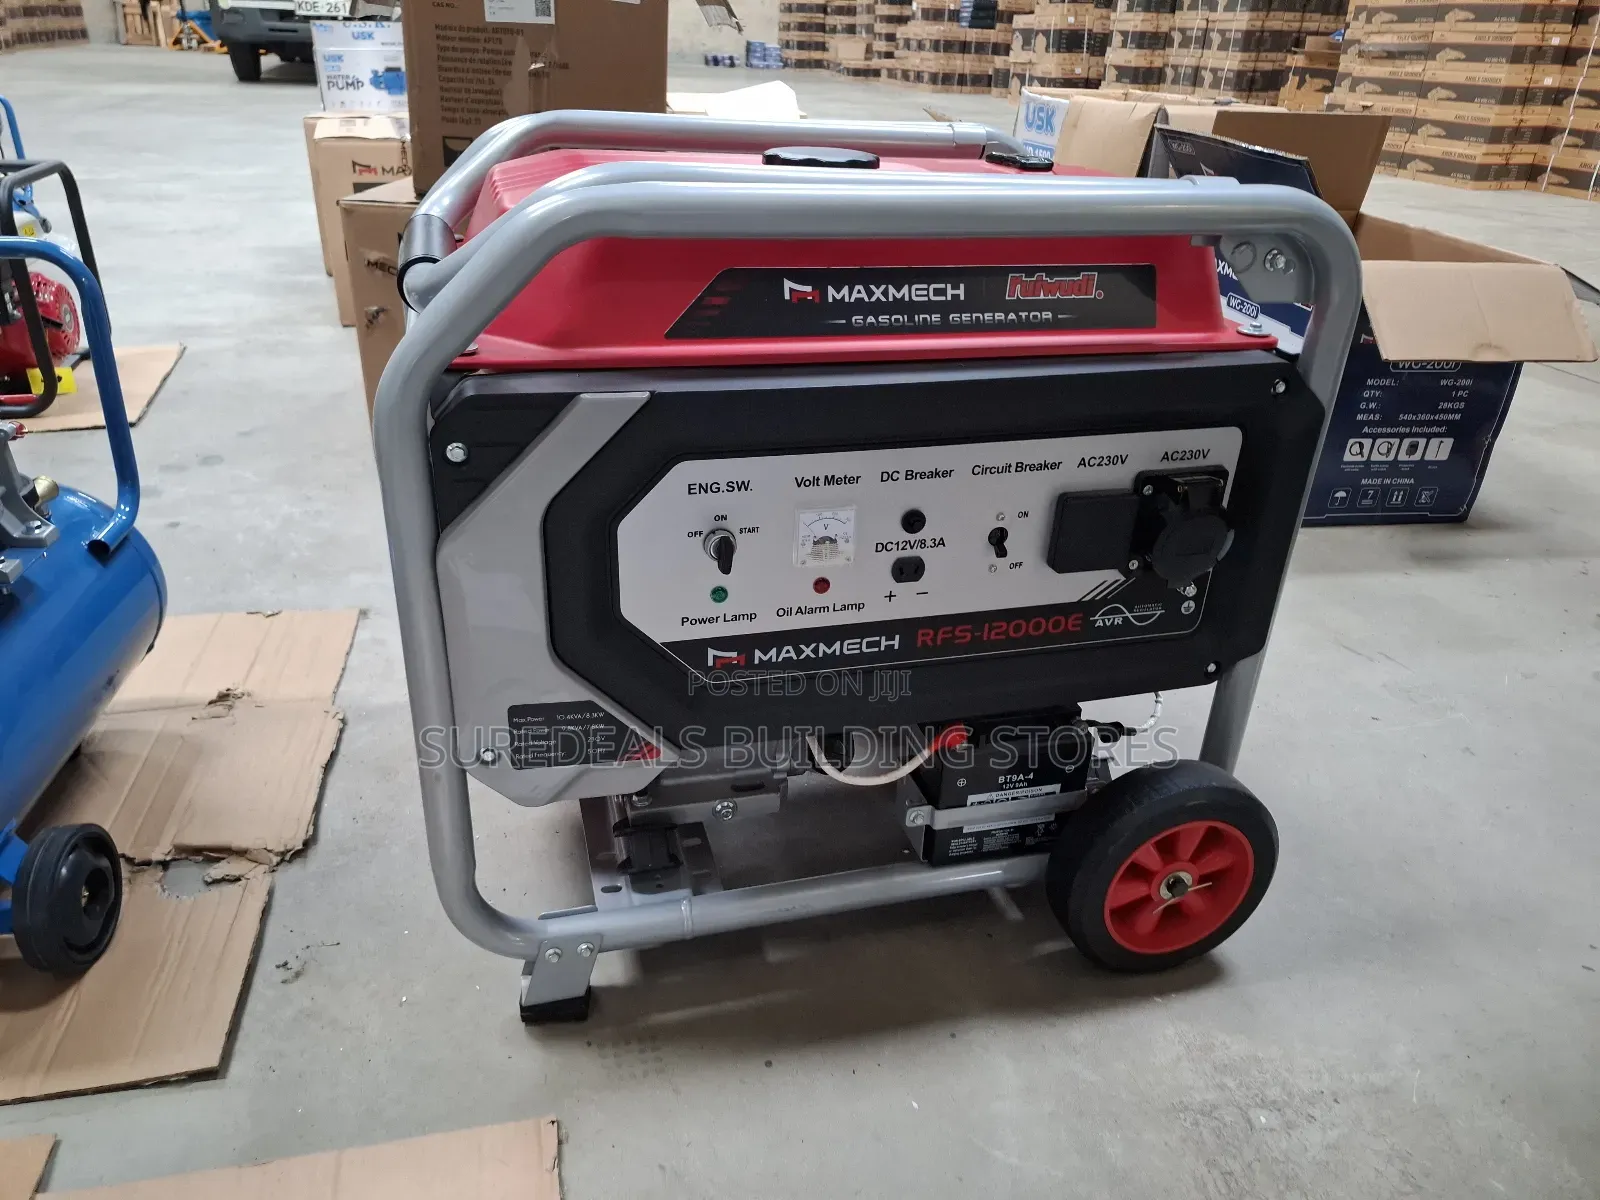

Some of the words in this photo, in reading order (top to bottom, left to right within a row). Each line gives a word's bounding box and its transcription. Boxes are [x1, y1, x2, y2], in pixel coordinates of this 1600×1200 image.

[296, 2, 321, 12] KDE
[326, 2, 348, 13] 261
[351, 31, 375, 40] USK
[323, 54, 344, 62] USK
[326, 80, 365, 91] PUMP
[1025, 103, 1056, 135] USK
[827, 283, 965, 303] MAXMECH
[851, 314, 942, 327] GASOLINE
[949, 311, 1053, 325] GENERATOR
[1366, 378, 1400, 386] MODEL:
[1363, 390, 1382, 398] QTY:
[1398, 413, 1461, 421] 540x360x450MM
[1362, 425, 1410, 433] Accessories
[1411, 425, 1447, 433] Included:
[1077, 454, 1129, 468] AC230V
[1160, 449, 1211, 463] AC230V
[880, 470, 900, 483] DC
[904, 467, 955, 481] Breaker
[971, 463, 1012, 476] Circuit
[1014, 460, 1063, 473] Breaker
[687, 480, 753, 495] ENG.SW.
[794, 476, 820, 488] Volt
[823, 474, 861, 487] Meter
[687, 530, 704, 538] OFF
[739, 526, 760, 534] START
[874, 537, 946, 553] DC12V/8.3A
[1009, 561, 1023, 570] OFF
[776, 606, 793, 617] Oil
[794, 604, 830, 616] Alarm
[832, 601, 866, 614] Lamp
[681, 614, 721, 627] Power
[723, 611, 757, 624] Lamp
[1094, 617, 1123, 627] AVR
[753, 634, 900, 665] MAXMECH
[916, 612, 1083, 647] RFS-12000E
[998, 772, 1034, 784] BT9A-4
